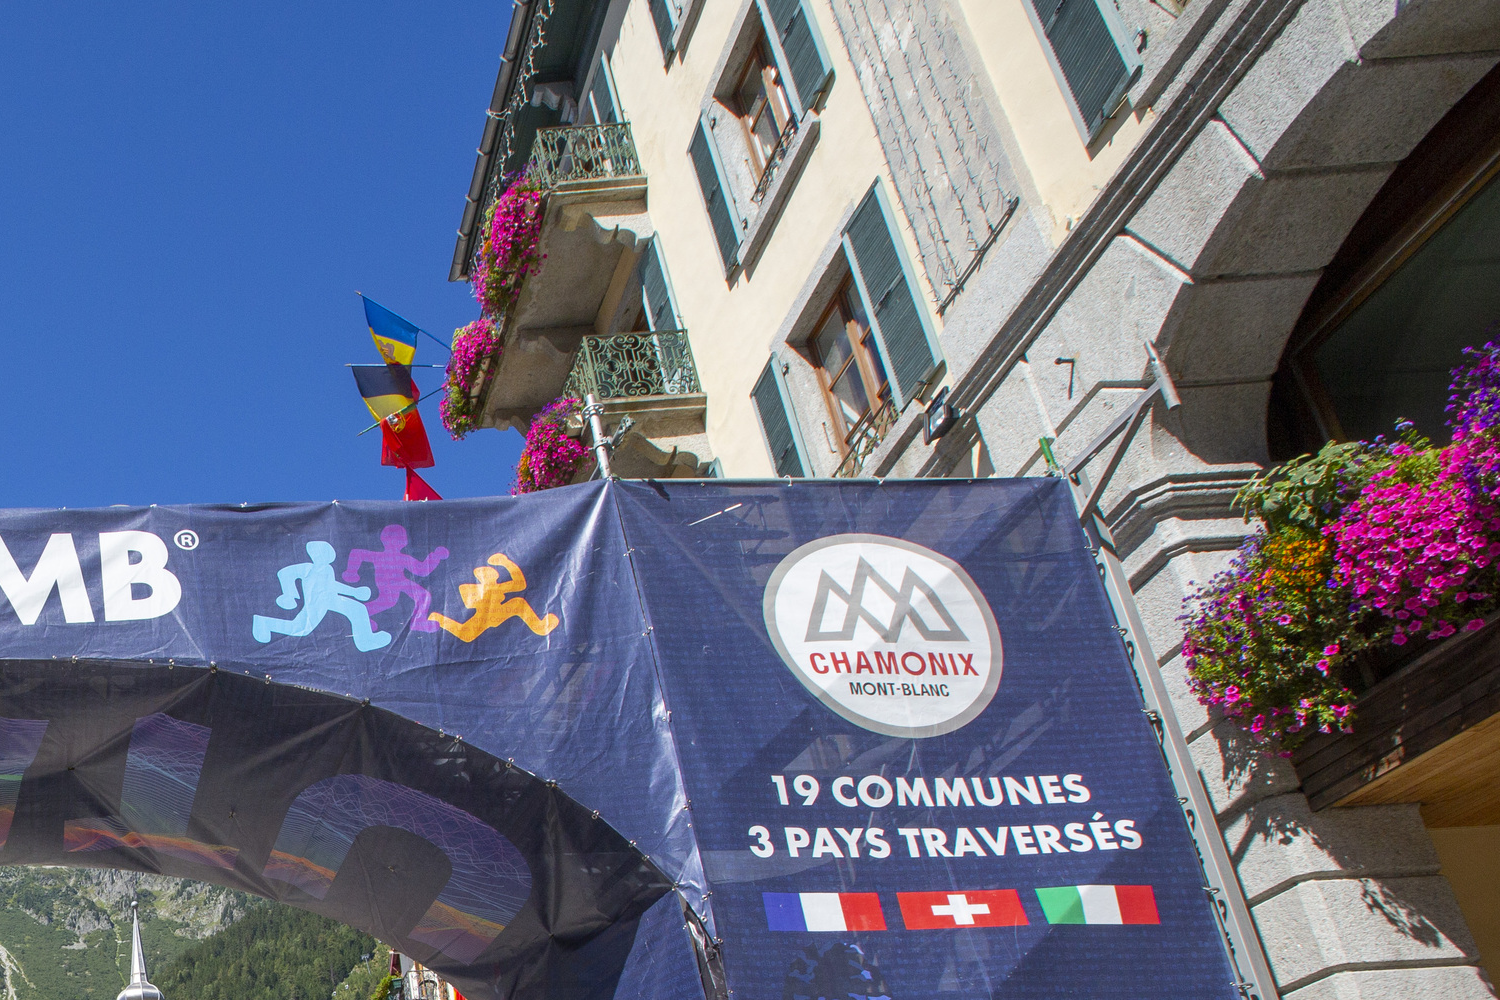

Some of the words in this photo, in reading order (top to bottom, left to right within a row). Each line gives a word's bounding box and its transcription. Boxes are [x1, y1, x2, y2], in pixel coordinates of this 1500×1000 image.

[809, 650, 980, 677] CHAMONIX
[848, 681, 950, 698] MONT-BLANC
[771, 775, 820, 807] 19
[832, 774, 1091, 808] COMMUNES
[748, 826, 775, 859] 3
[784, 826, 892, 859] PAYS
[898, 811, 1143, 860] TRAVERSÉS
